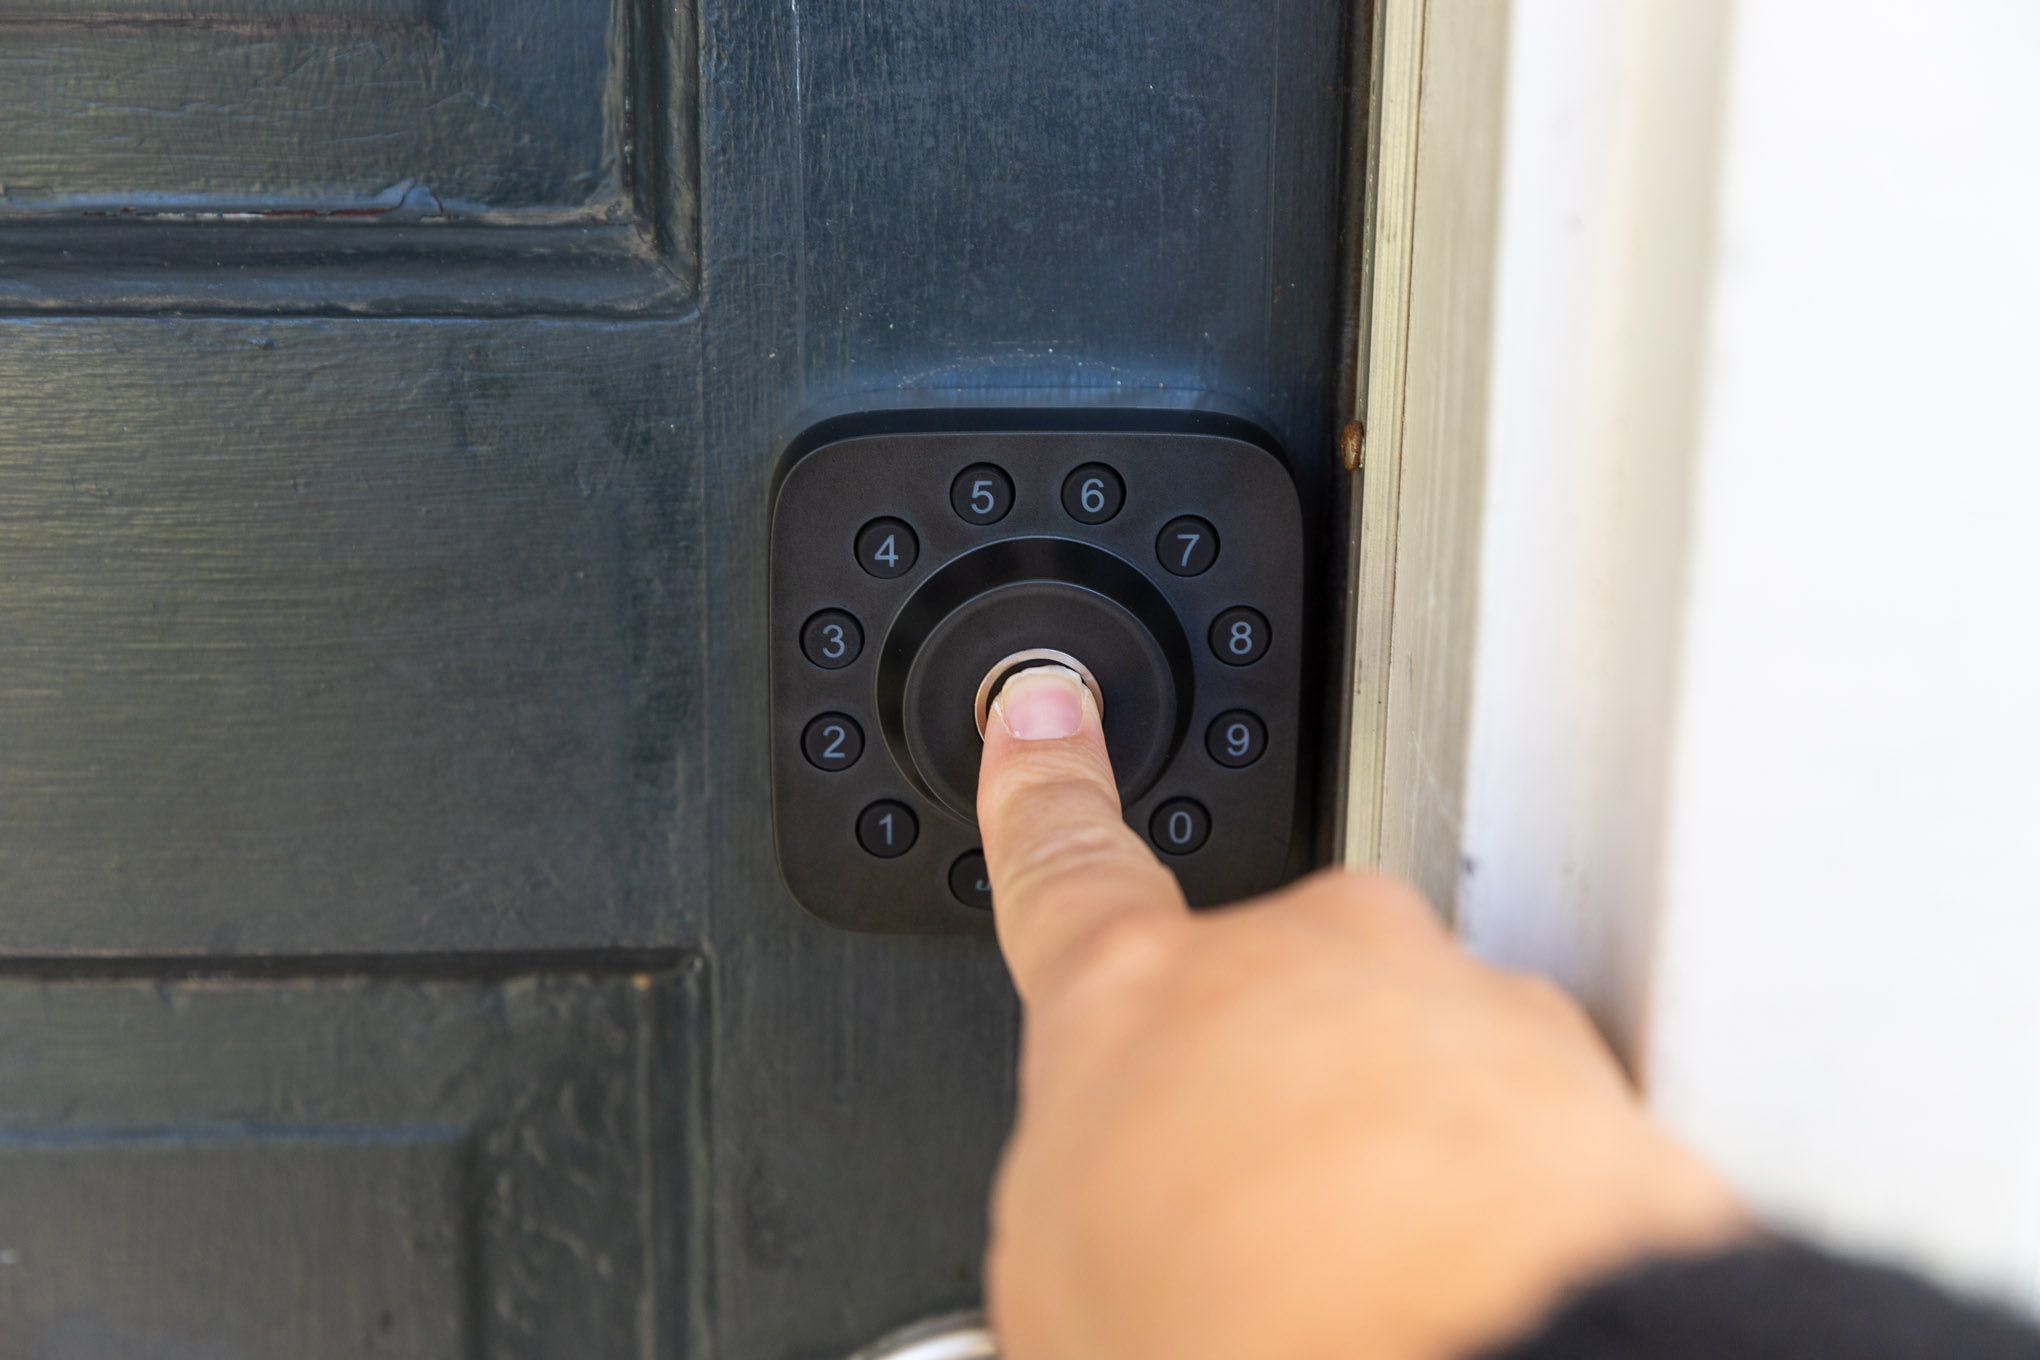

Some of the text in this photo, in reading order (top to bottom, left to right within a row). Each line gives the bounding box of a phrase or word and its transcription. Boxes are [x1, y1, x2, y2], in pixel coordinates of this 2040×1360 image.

[972, 481, 993, 513] 5
[1082, 479, 1104, 512] 6
[874, 535, 898, 567] 4
[1177, 535, 1200, 567] 7
[823, 625, 845, 657] 3
[1230, 622, 1251, 654] 8
[824, 726, 845, 757] 2
[1228, 724, 1249, 755] 9
[879, 813, 892, 843] 1
[1169, 812, 1191, 843] 0
